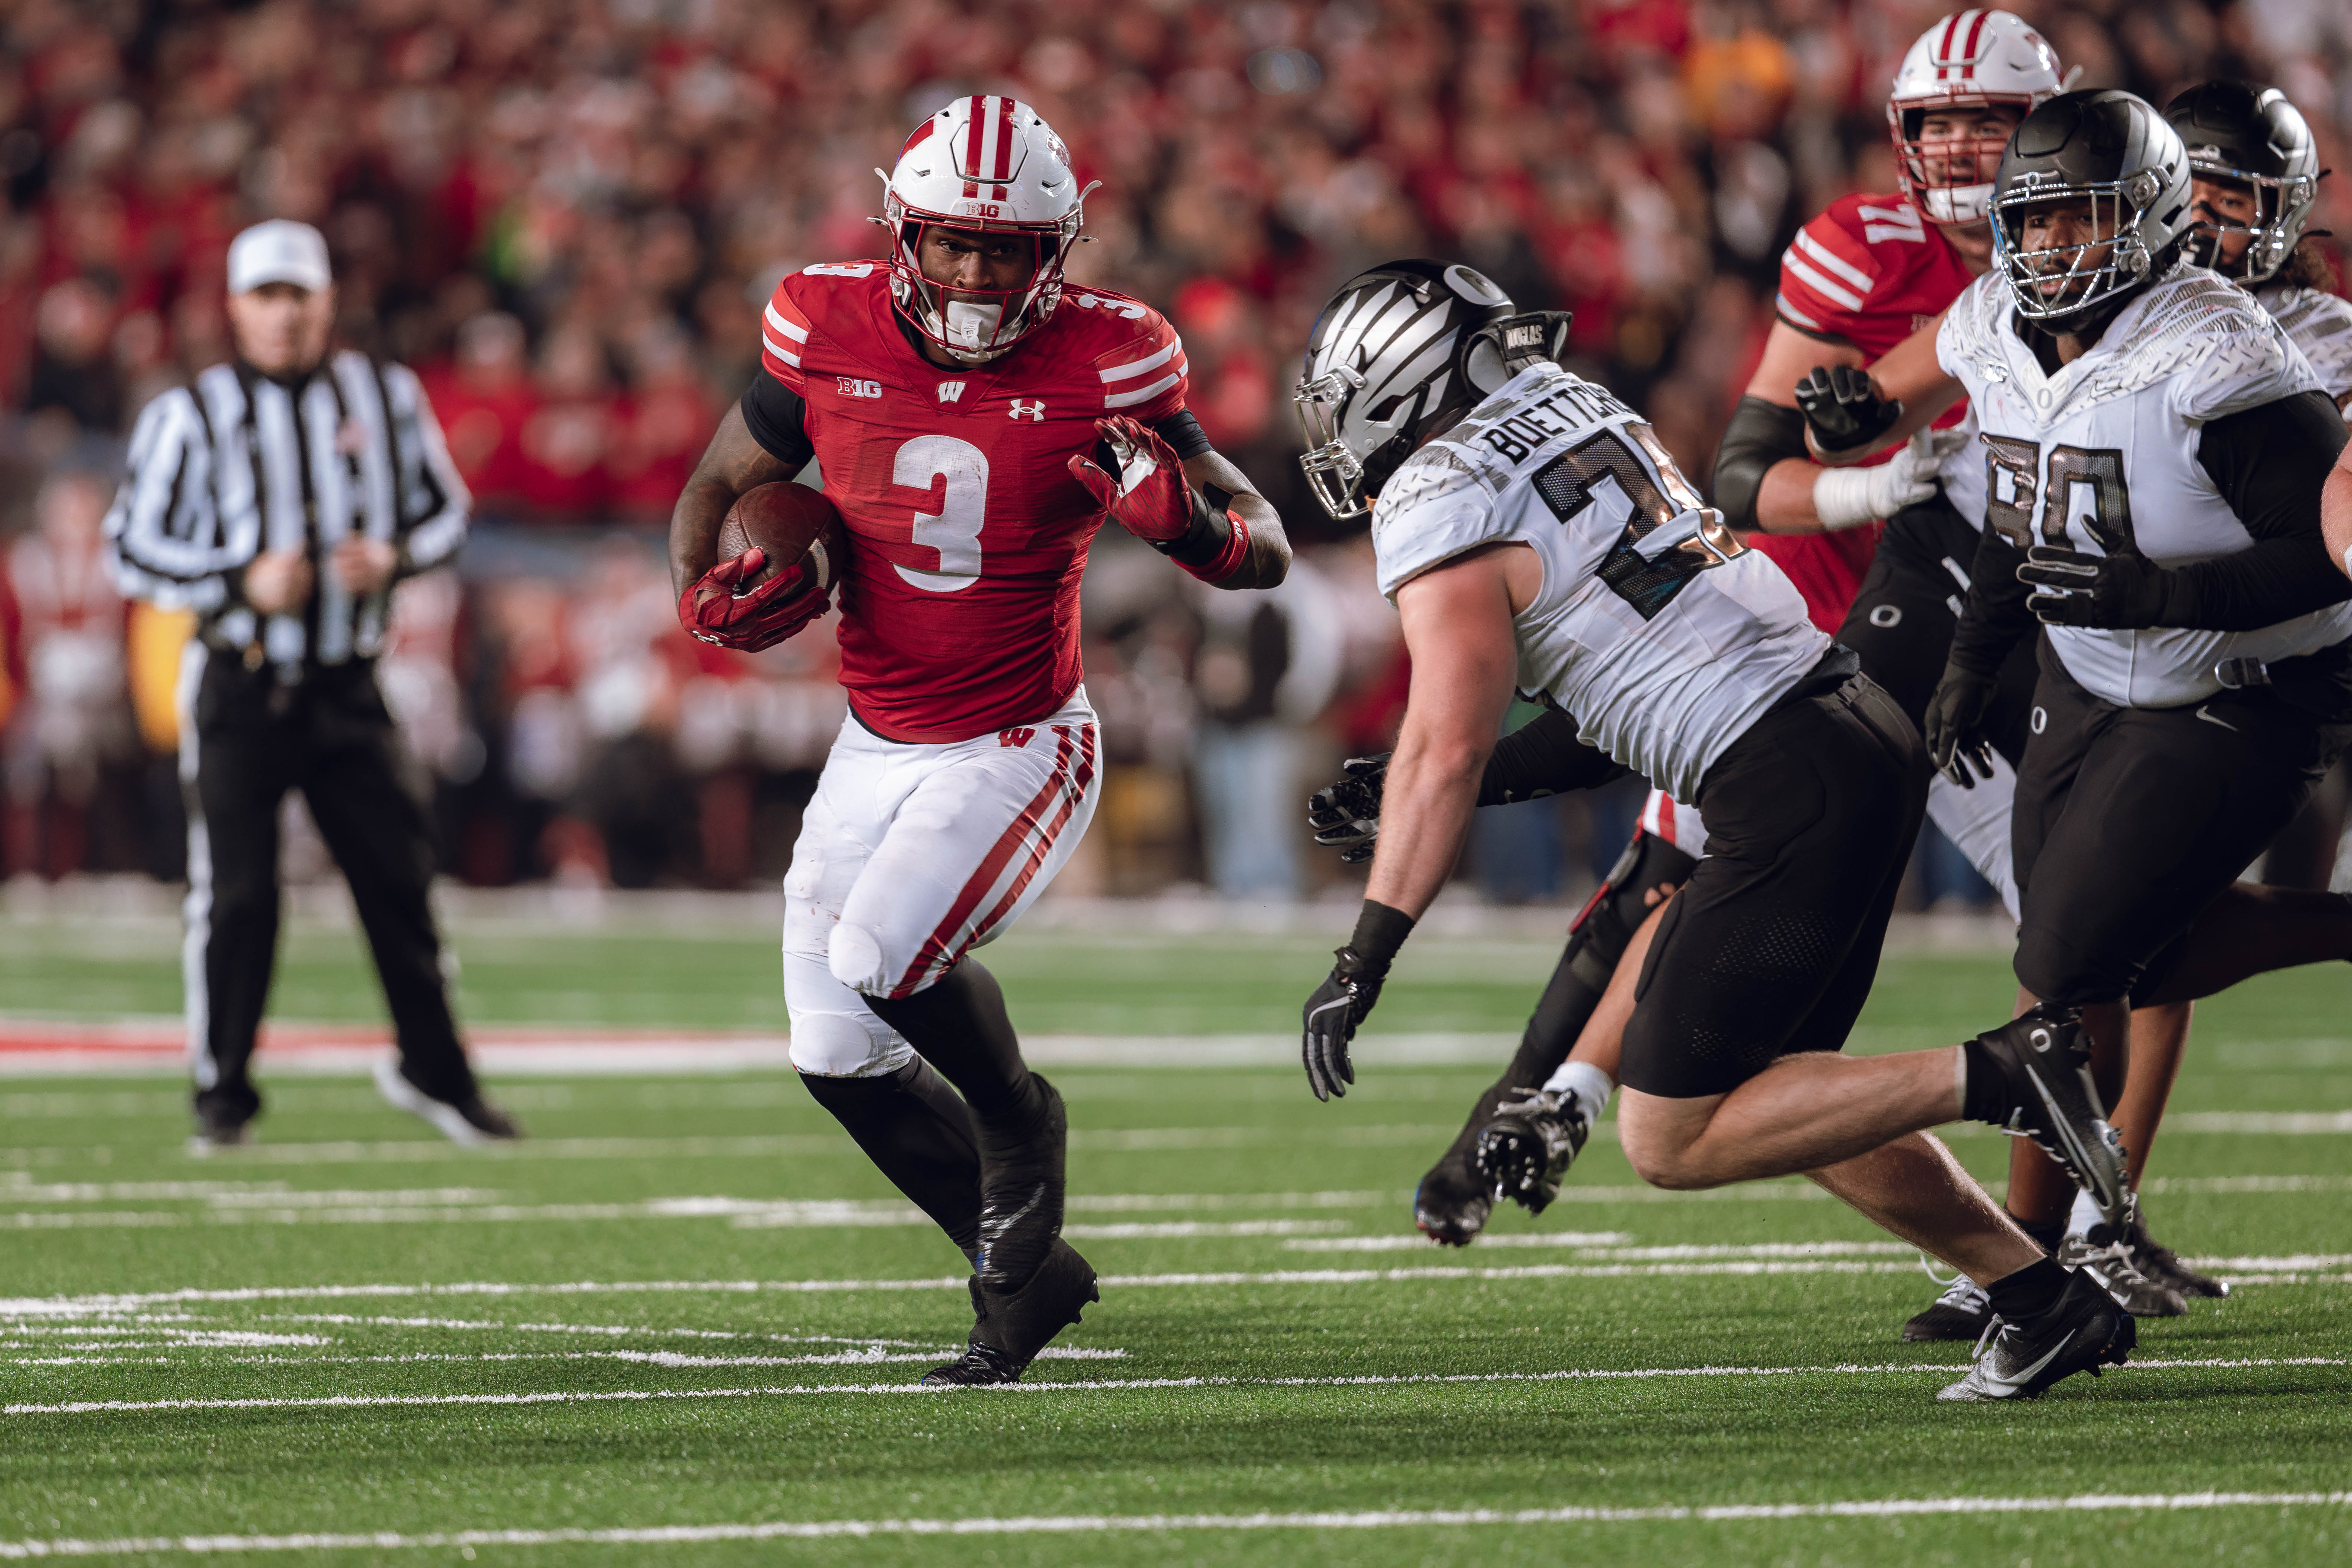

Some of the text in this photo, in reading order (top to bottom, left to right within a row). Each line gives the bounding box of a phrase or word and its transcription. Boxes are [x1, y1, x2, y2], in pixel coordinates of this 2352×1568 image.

[1078, 294, 1147, 319] 3
[937, 381, 966, 404] W
[892, 435, 989, 592] 3
